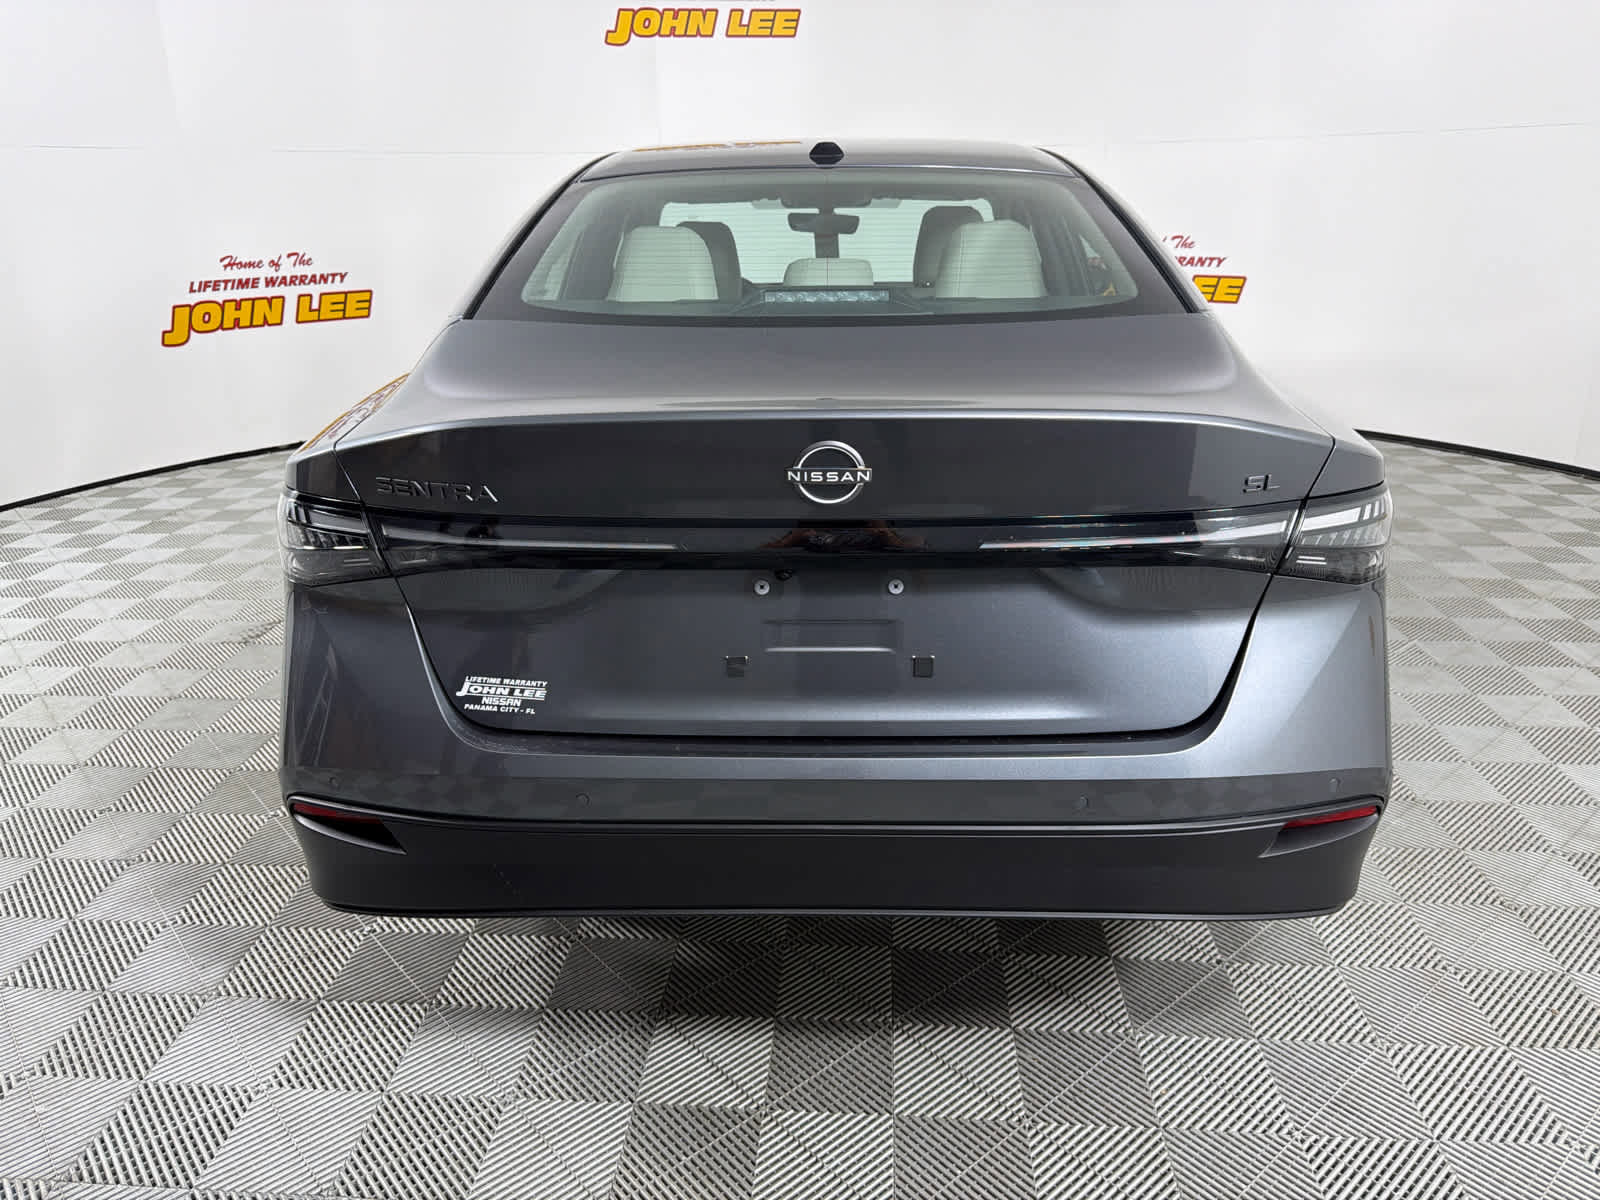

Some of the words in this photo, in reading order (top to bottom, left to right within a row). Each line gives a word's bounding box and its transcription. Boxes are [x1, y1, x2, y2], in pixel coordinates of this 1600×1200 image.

[604, 7, 719, 46] JOHN
[725, 8, 801, 38] LEE
[1171, 234, 1196, 249] The
[219, 254, 265, 271] Home
[267, 254, 283, 273] of
[286, 251, 314, 268] The
[1174, 255, 1229, 268] RANTY
[188, 276, 261, 294] LIFETIME
[264, 271, 349, 289] WARRANTY
[1191, 274, 1247, 304] EE
[161, 295, 286, 348] JOHN
[295, 289, 373, 324] LEE
[786, 470, 871, 483] NISSAN
[1242, 473, 1281, 494] SL
[375, 475, 499, 503] SENTRA
[455, 681, 511, 697] JOHN
[513, 688, 548, 699] LEE
[465, 675, 502, 684] LIFETIME
[503, 678, 548, 688] WARRANTY
[463, 703, 498, 713] PANAMA
[500, 706, 519, 714] CITY
[481, 696, 522, 707] NISSAN
